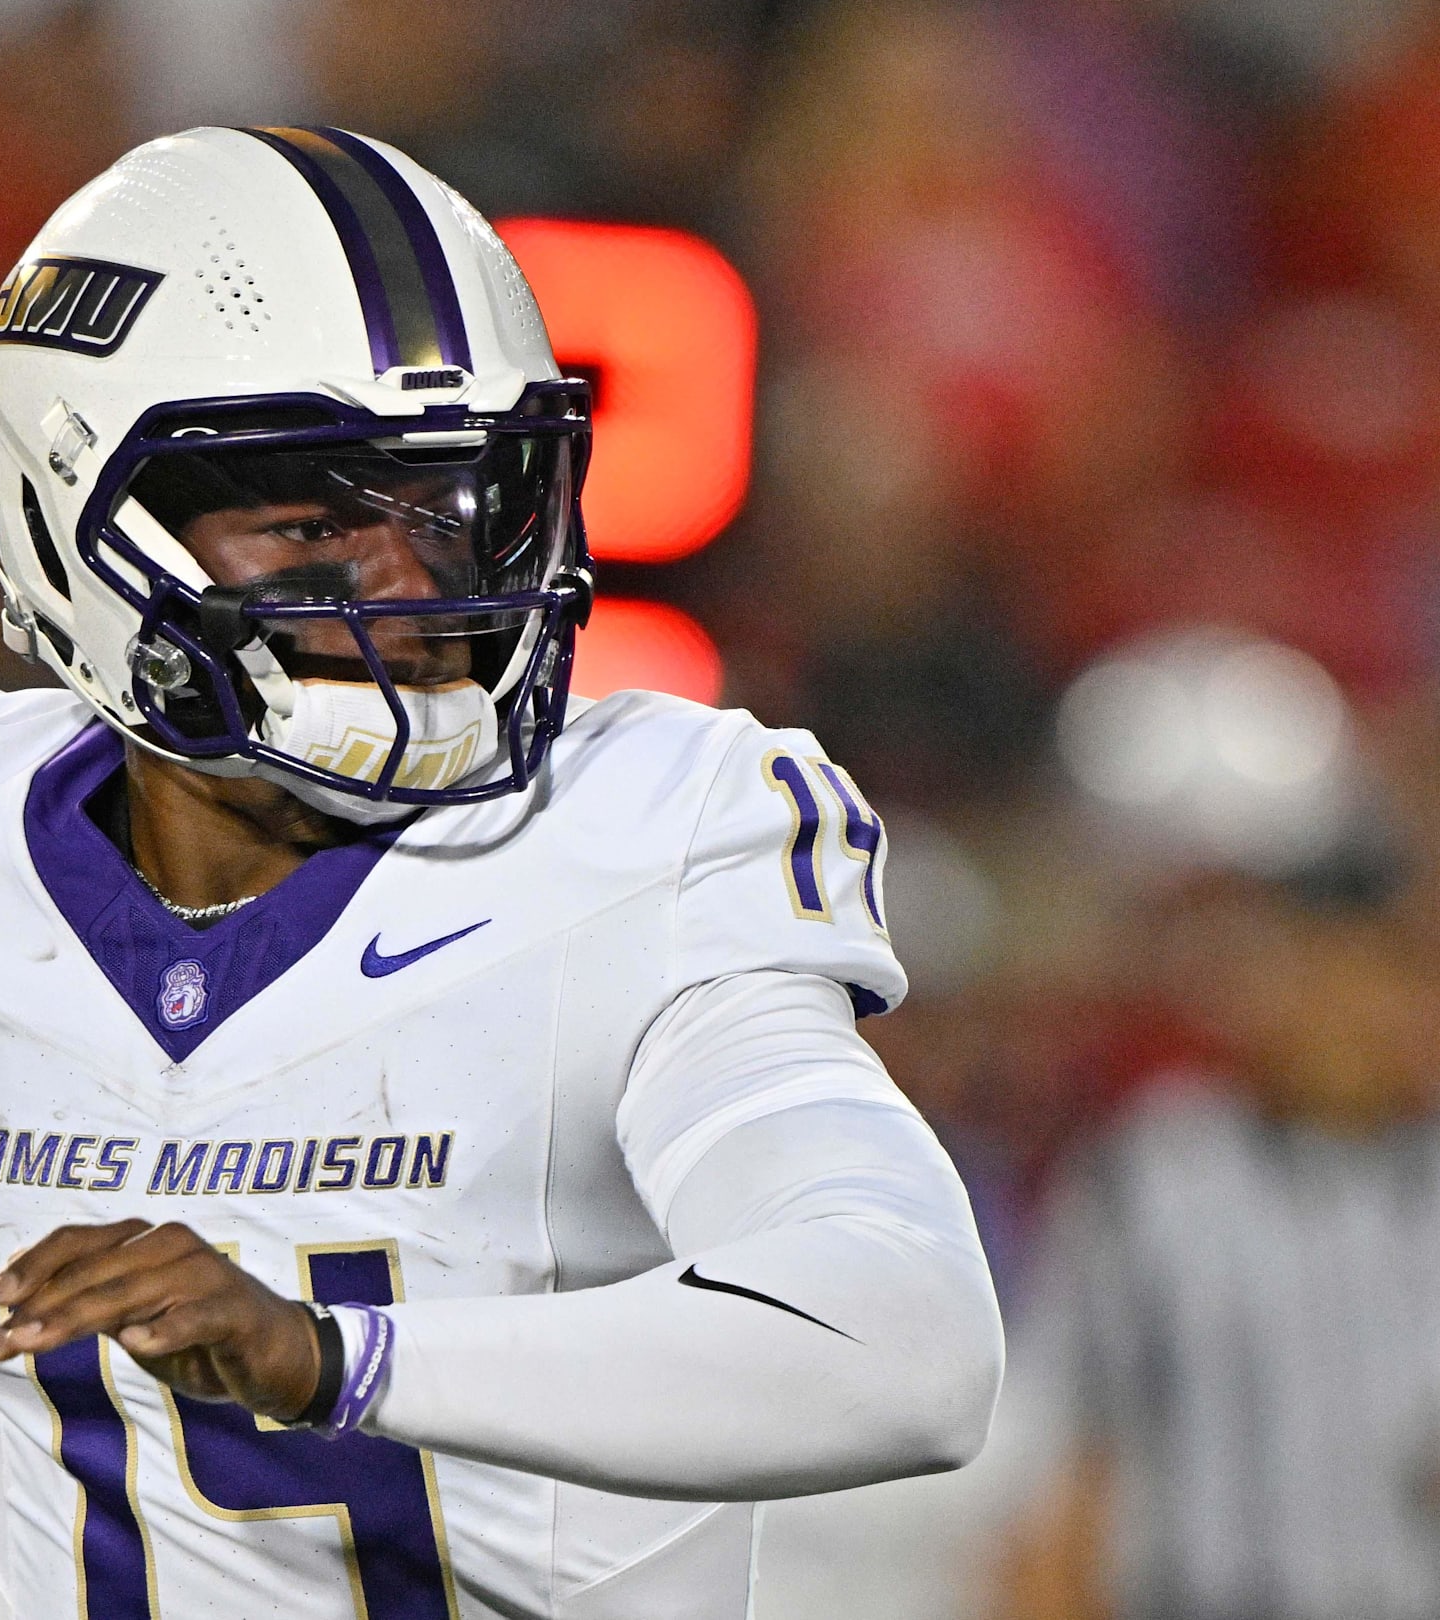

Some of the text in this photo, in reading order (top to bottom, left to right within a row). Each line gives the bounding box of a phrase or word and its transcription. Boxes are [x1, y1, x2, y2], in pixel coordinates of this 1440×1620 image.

[401, 370, 464, 391] DUKES
[760, 748, 890, 943] 14
[146, 1129, 456, 1195] MADISON
